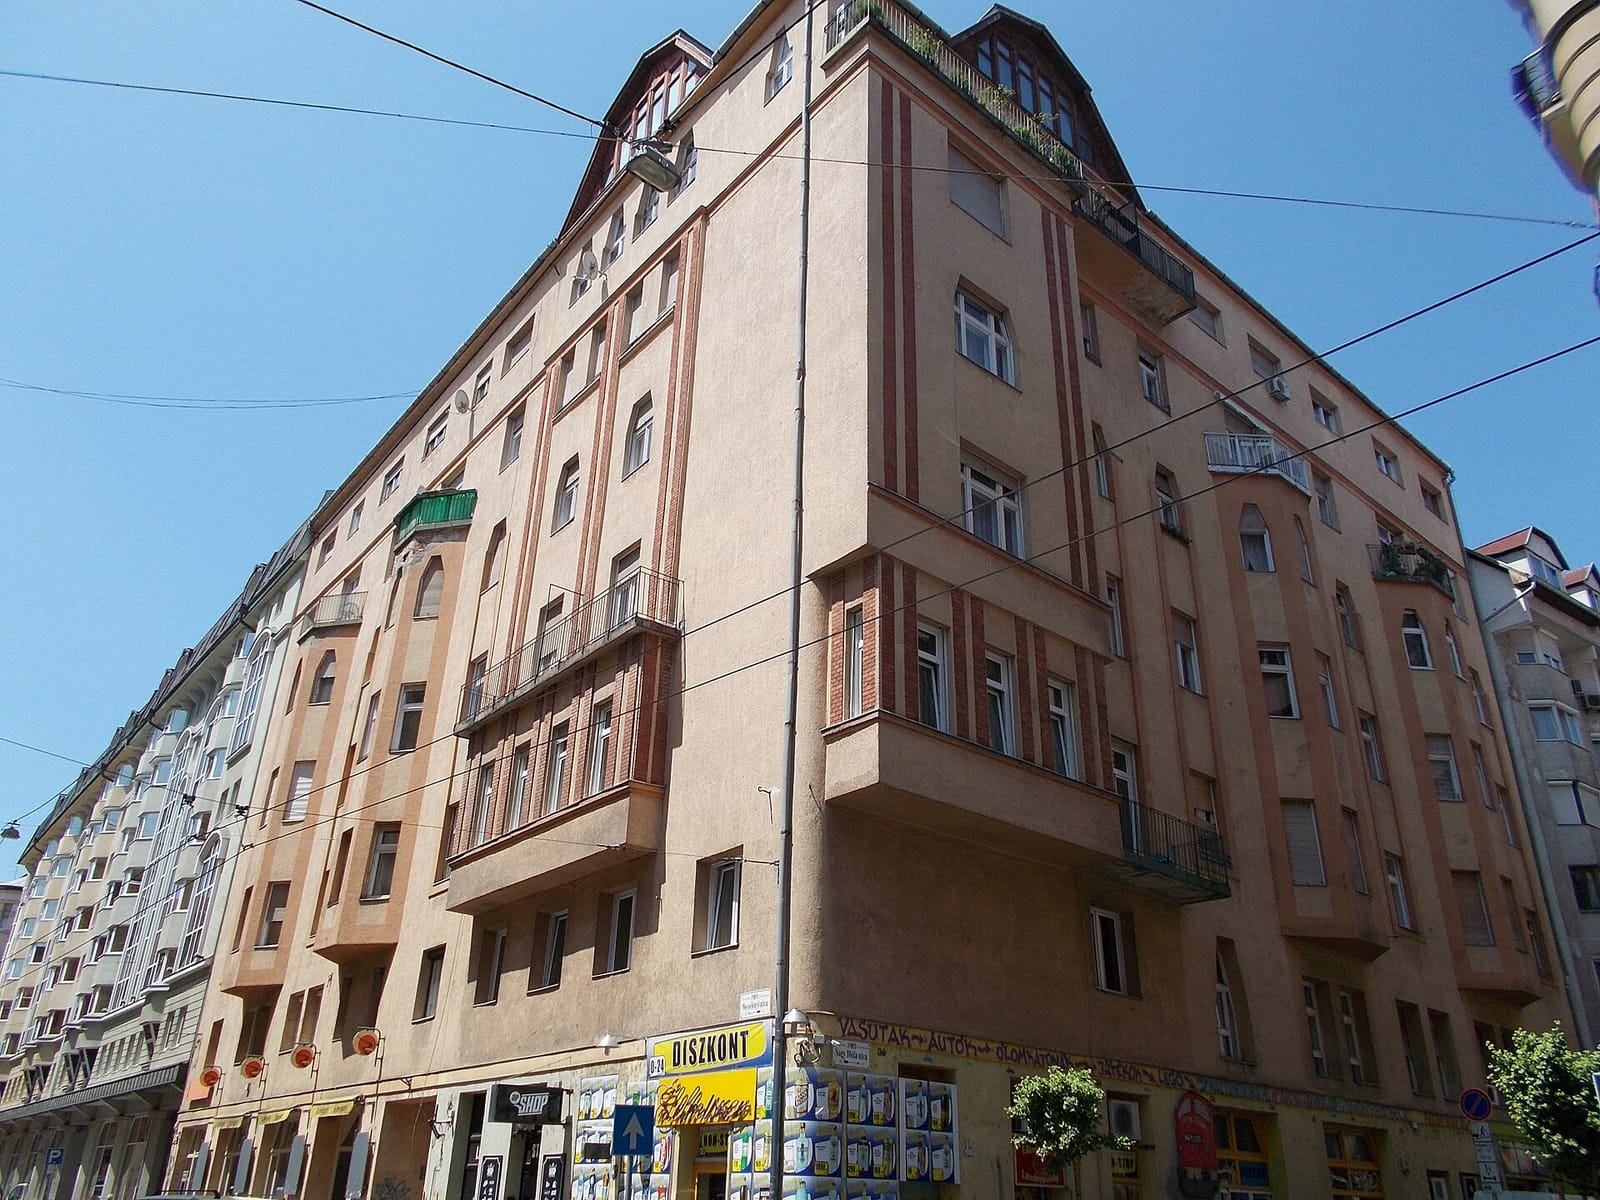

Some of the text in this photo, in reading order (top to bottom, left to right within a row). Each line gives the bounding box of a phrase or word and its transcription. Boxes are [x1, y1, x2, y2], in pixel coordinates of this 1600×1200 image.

[672, 1030, 749, 1067] DISZKONT
[518, 1095, 549, 1113] SHOP
[48, 1149, 62, 1164] P
